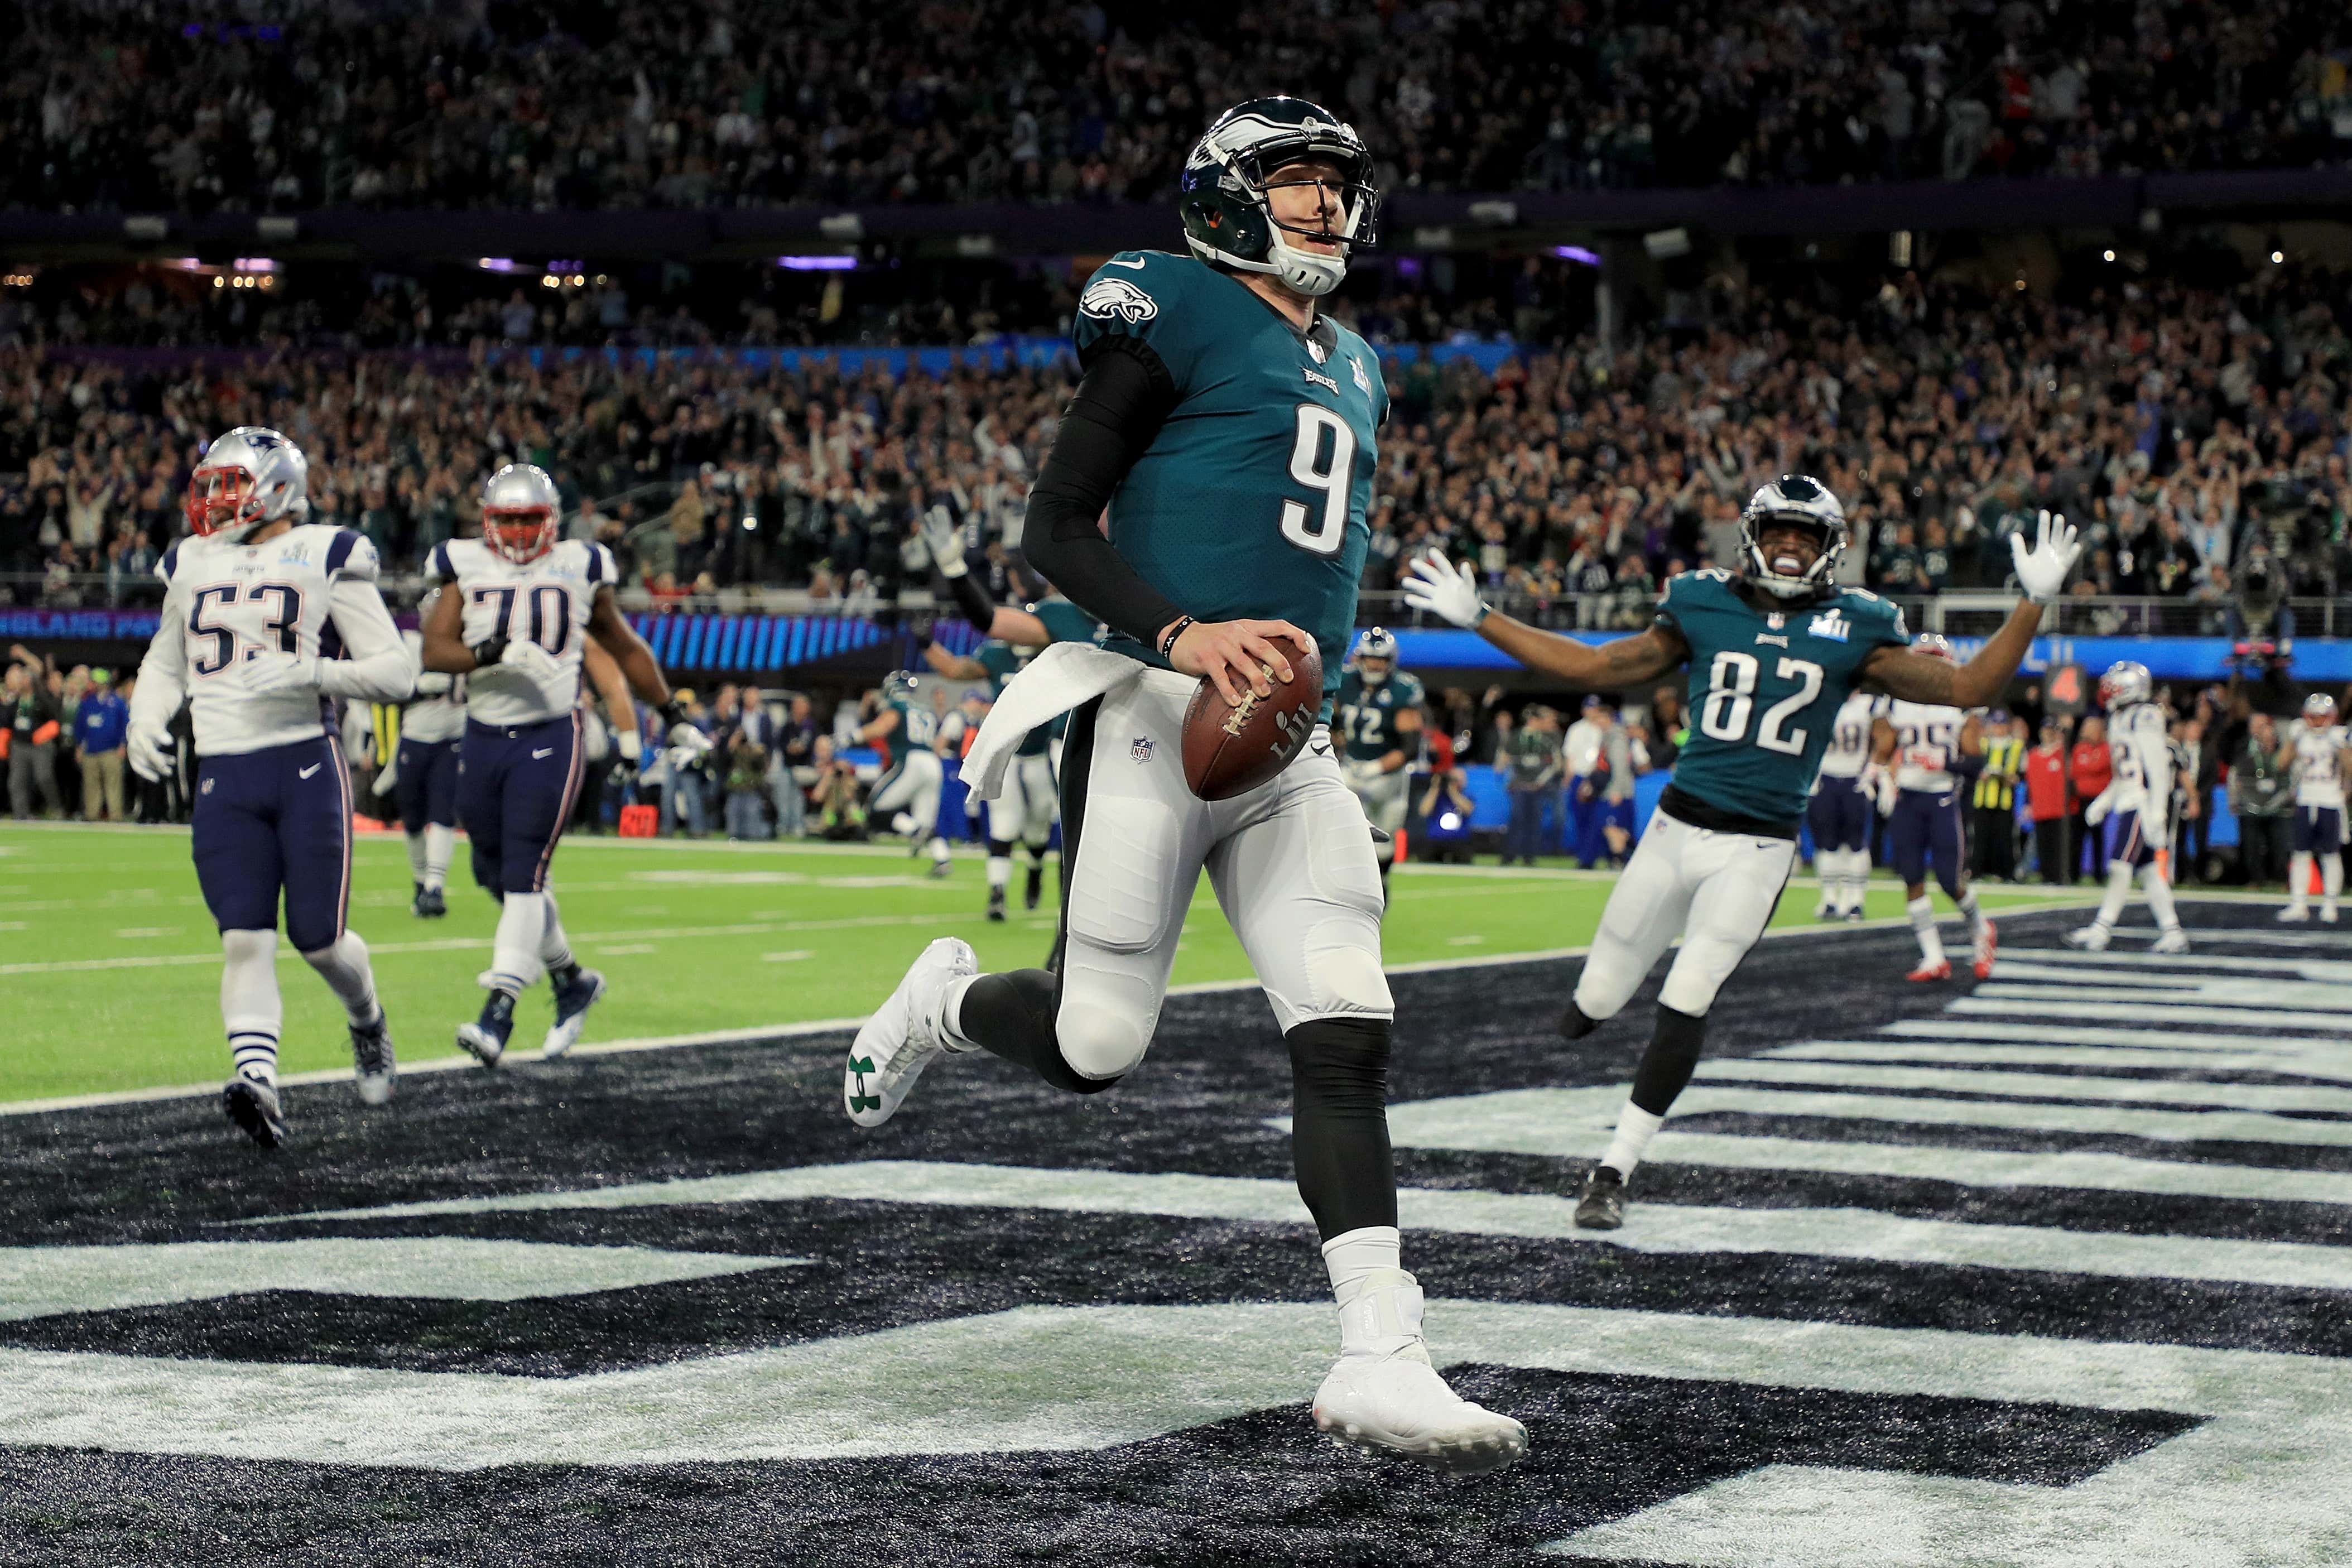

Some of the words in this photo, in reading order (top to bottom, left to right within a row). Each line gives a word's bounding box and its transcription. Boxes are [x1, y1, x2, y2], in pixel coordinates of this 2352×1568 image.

[1300, 367, 1339, 397] EAGLES
[1279, 403, 1359, 556] 9
[186, 579, 305, 680] 53
[469, 580, 572, 658] 70
[1700, 650, 1824, 757] 82
